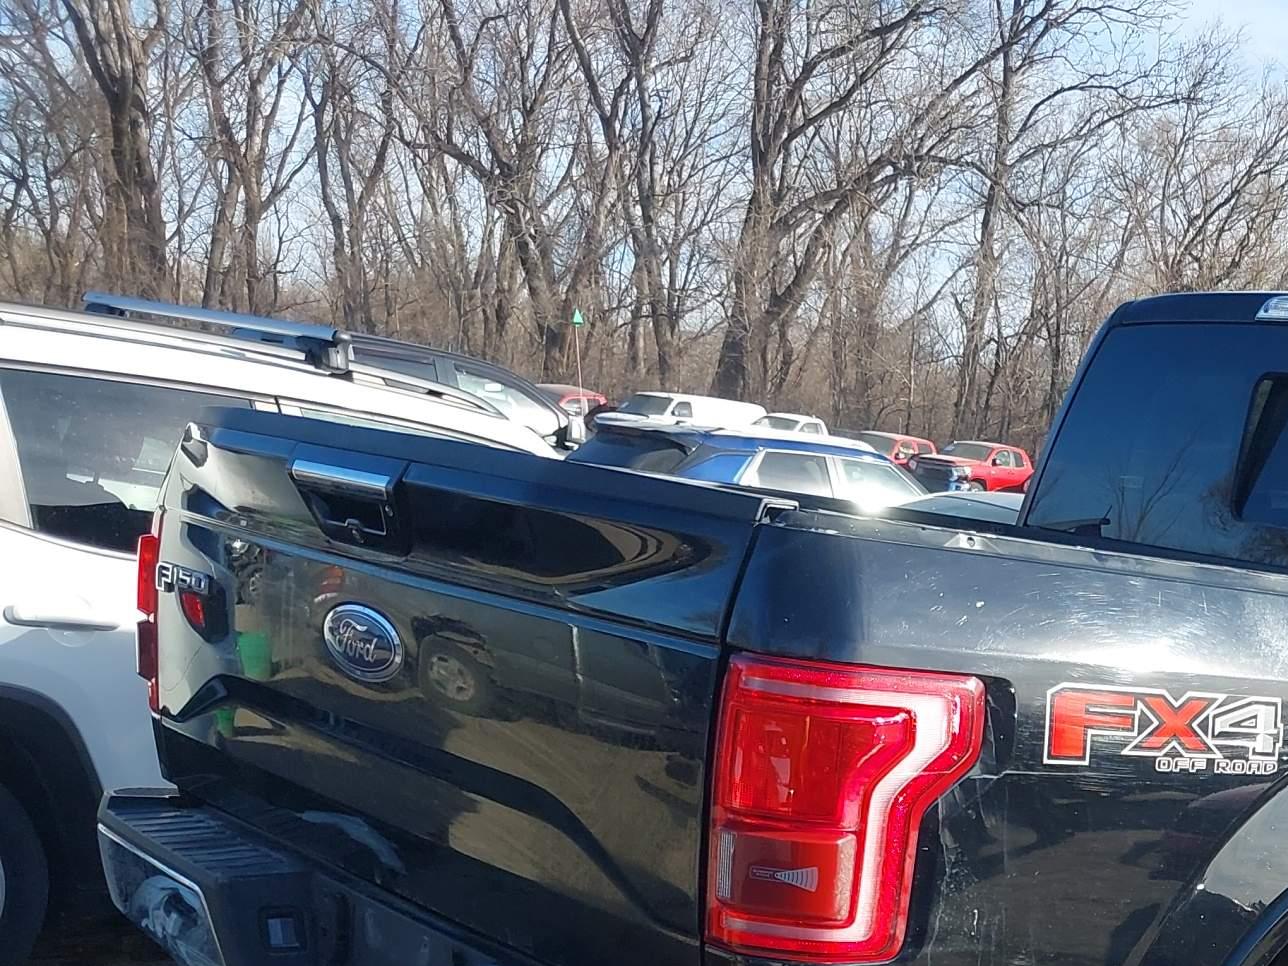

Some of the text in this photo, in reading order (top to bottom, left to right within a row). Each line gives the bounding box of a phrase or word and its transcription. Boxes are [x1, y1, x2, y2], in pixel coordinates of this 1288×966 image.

[336, 618, 379, 663] Ford
[1043, 682, 1284, 765] FX4
[1155, 757, 1279, 775] OFF ROAD
